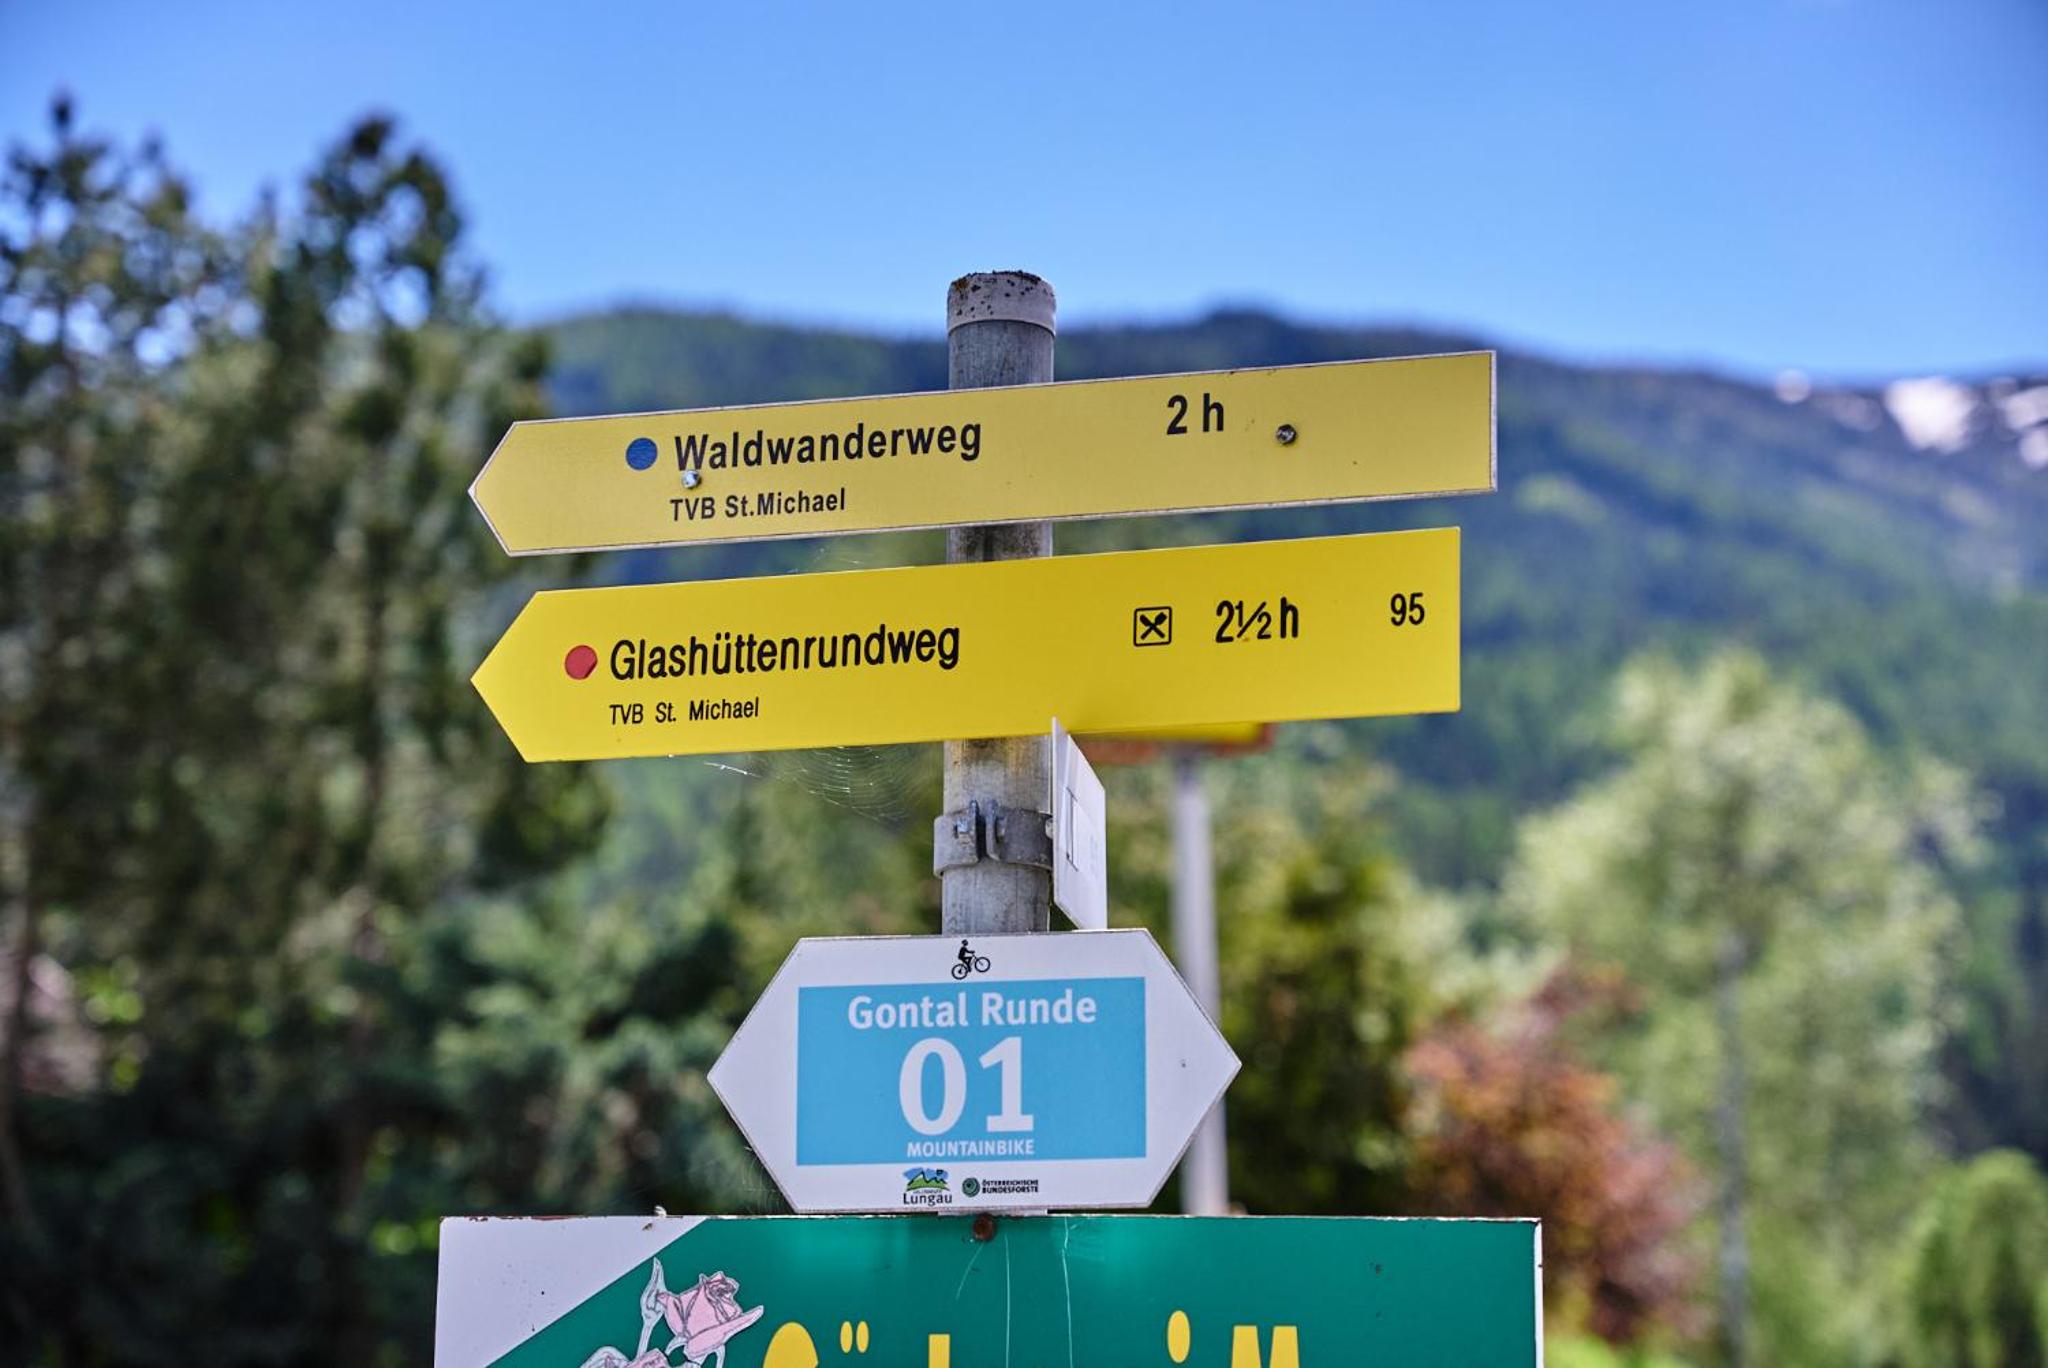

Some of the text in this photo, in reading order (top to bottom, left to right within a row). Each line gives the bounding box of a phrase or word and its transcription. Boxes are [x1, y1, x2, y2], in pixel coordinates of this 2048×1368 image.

[1166, 393, 1224, 435] 2 h
[674, 422, 982, 472] Waldwanderweg
[670, 488, 846, 521] TVB St.Michael
[1390, 592, 1425, 627] 95
[609, 623, 961, 681] Glashüttenrundweg
[609, 697, 759, 725] TVB St. Michael
[848, 988, 1098, 1030] Gontal Runde
[899, 1036, 1035, 1137] 01
[906, 1139, 1036, 1158] MOUNTAINBIKE
[903, 1193, 953, 1206] Lungau
